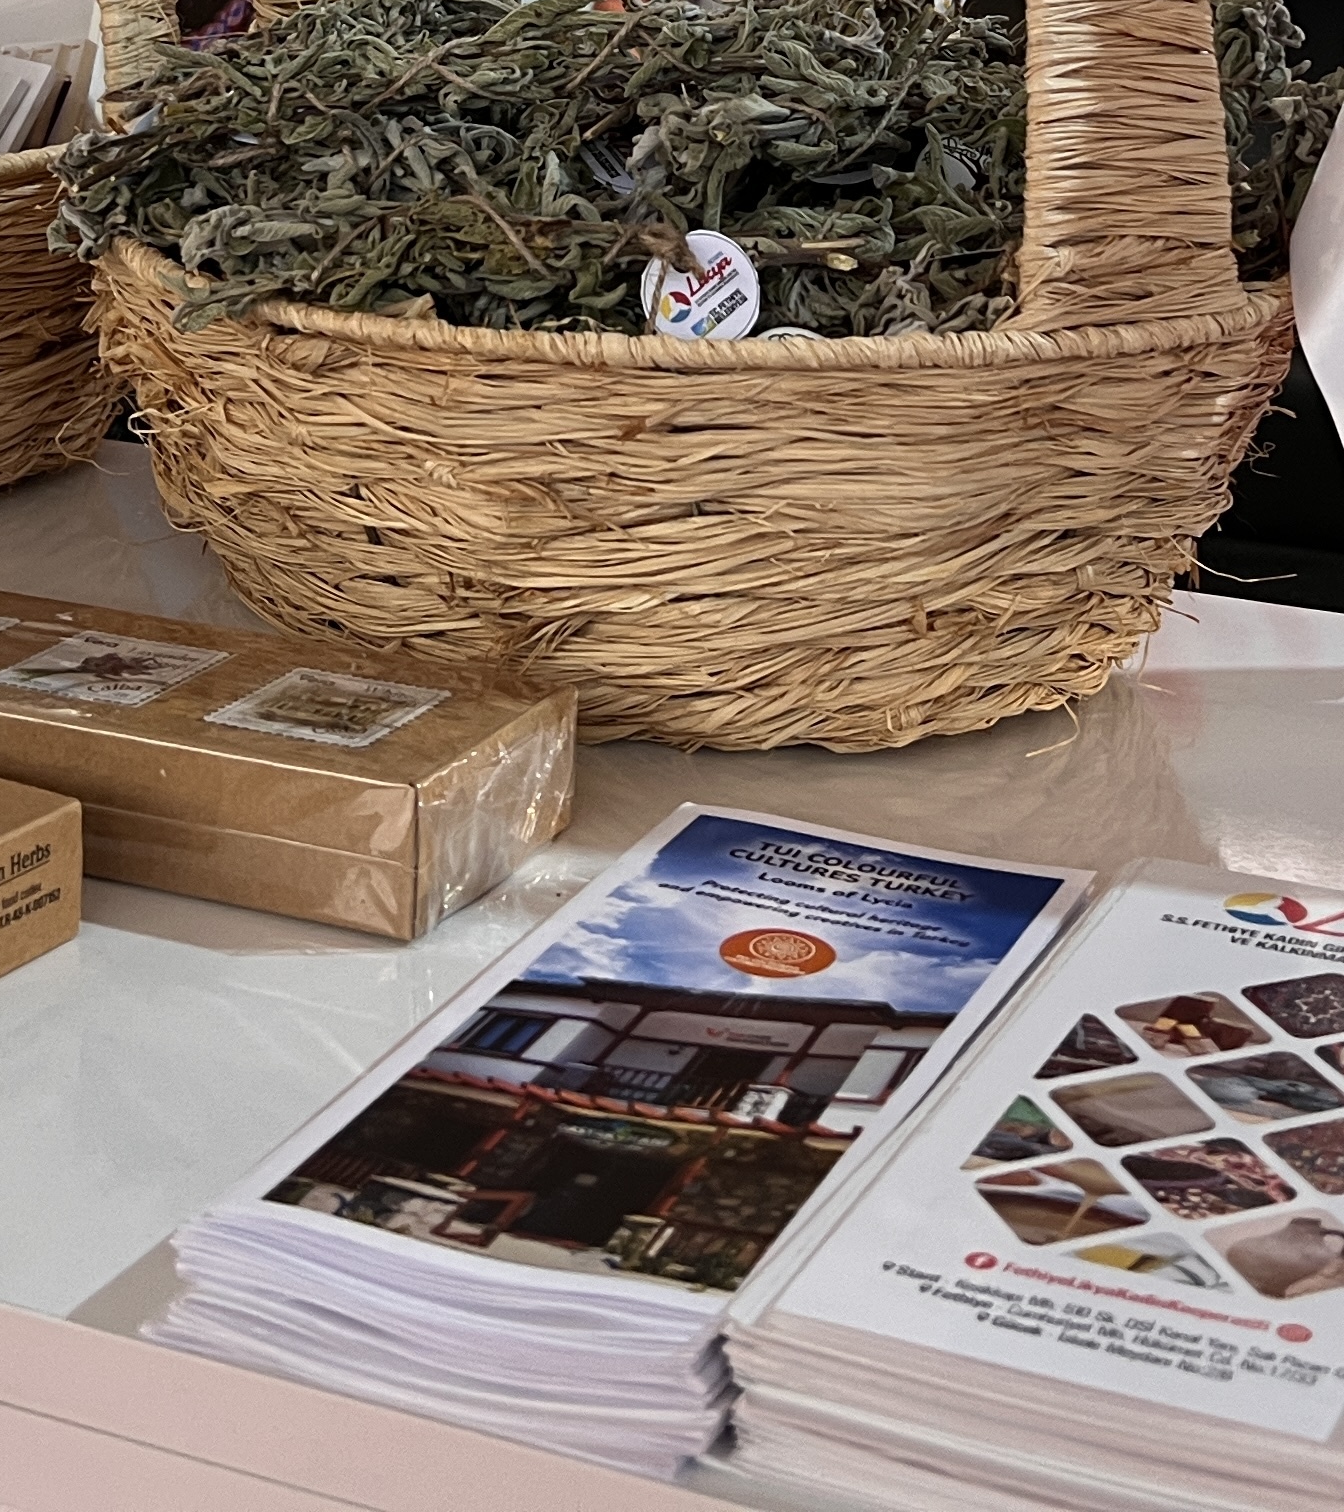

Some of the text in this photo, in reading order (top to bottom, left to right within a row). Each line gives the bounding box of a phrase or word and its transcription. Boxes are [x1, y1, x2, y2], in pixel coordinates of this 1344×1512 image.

[10, 843, 51, 875] Herbs
[729, 848, 974, 903] CULTURES TURKEY
[759, 841, 960, 888] TUI COLOURFUL
[695, 890, 800, 918] empowering
[701, 880, 791, 905] Protecting
[795, 901, 866, 919] cultural
[757, 871, 914, 909] Looms of Lycia
[1229, 934, 1252, 946] VE
[1264, 930, 1318, 949] KADIN
